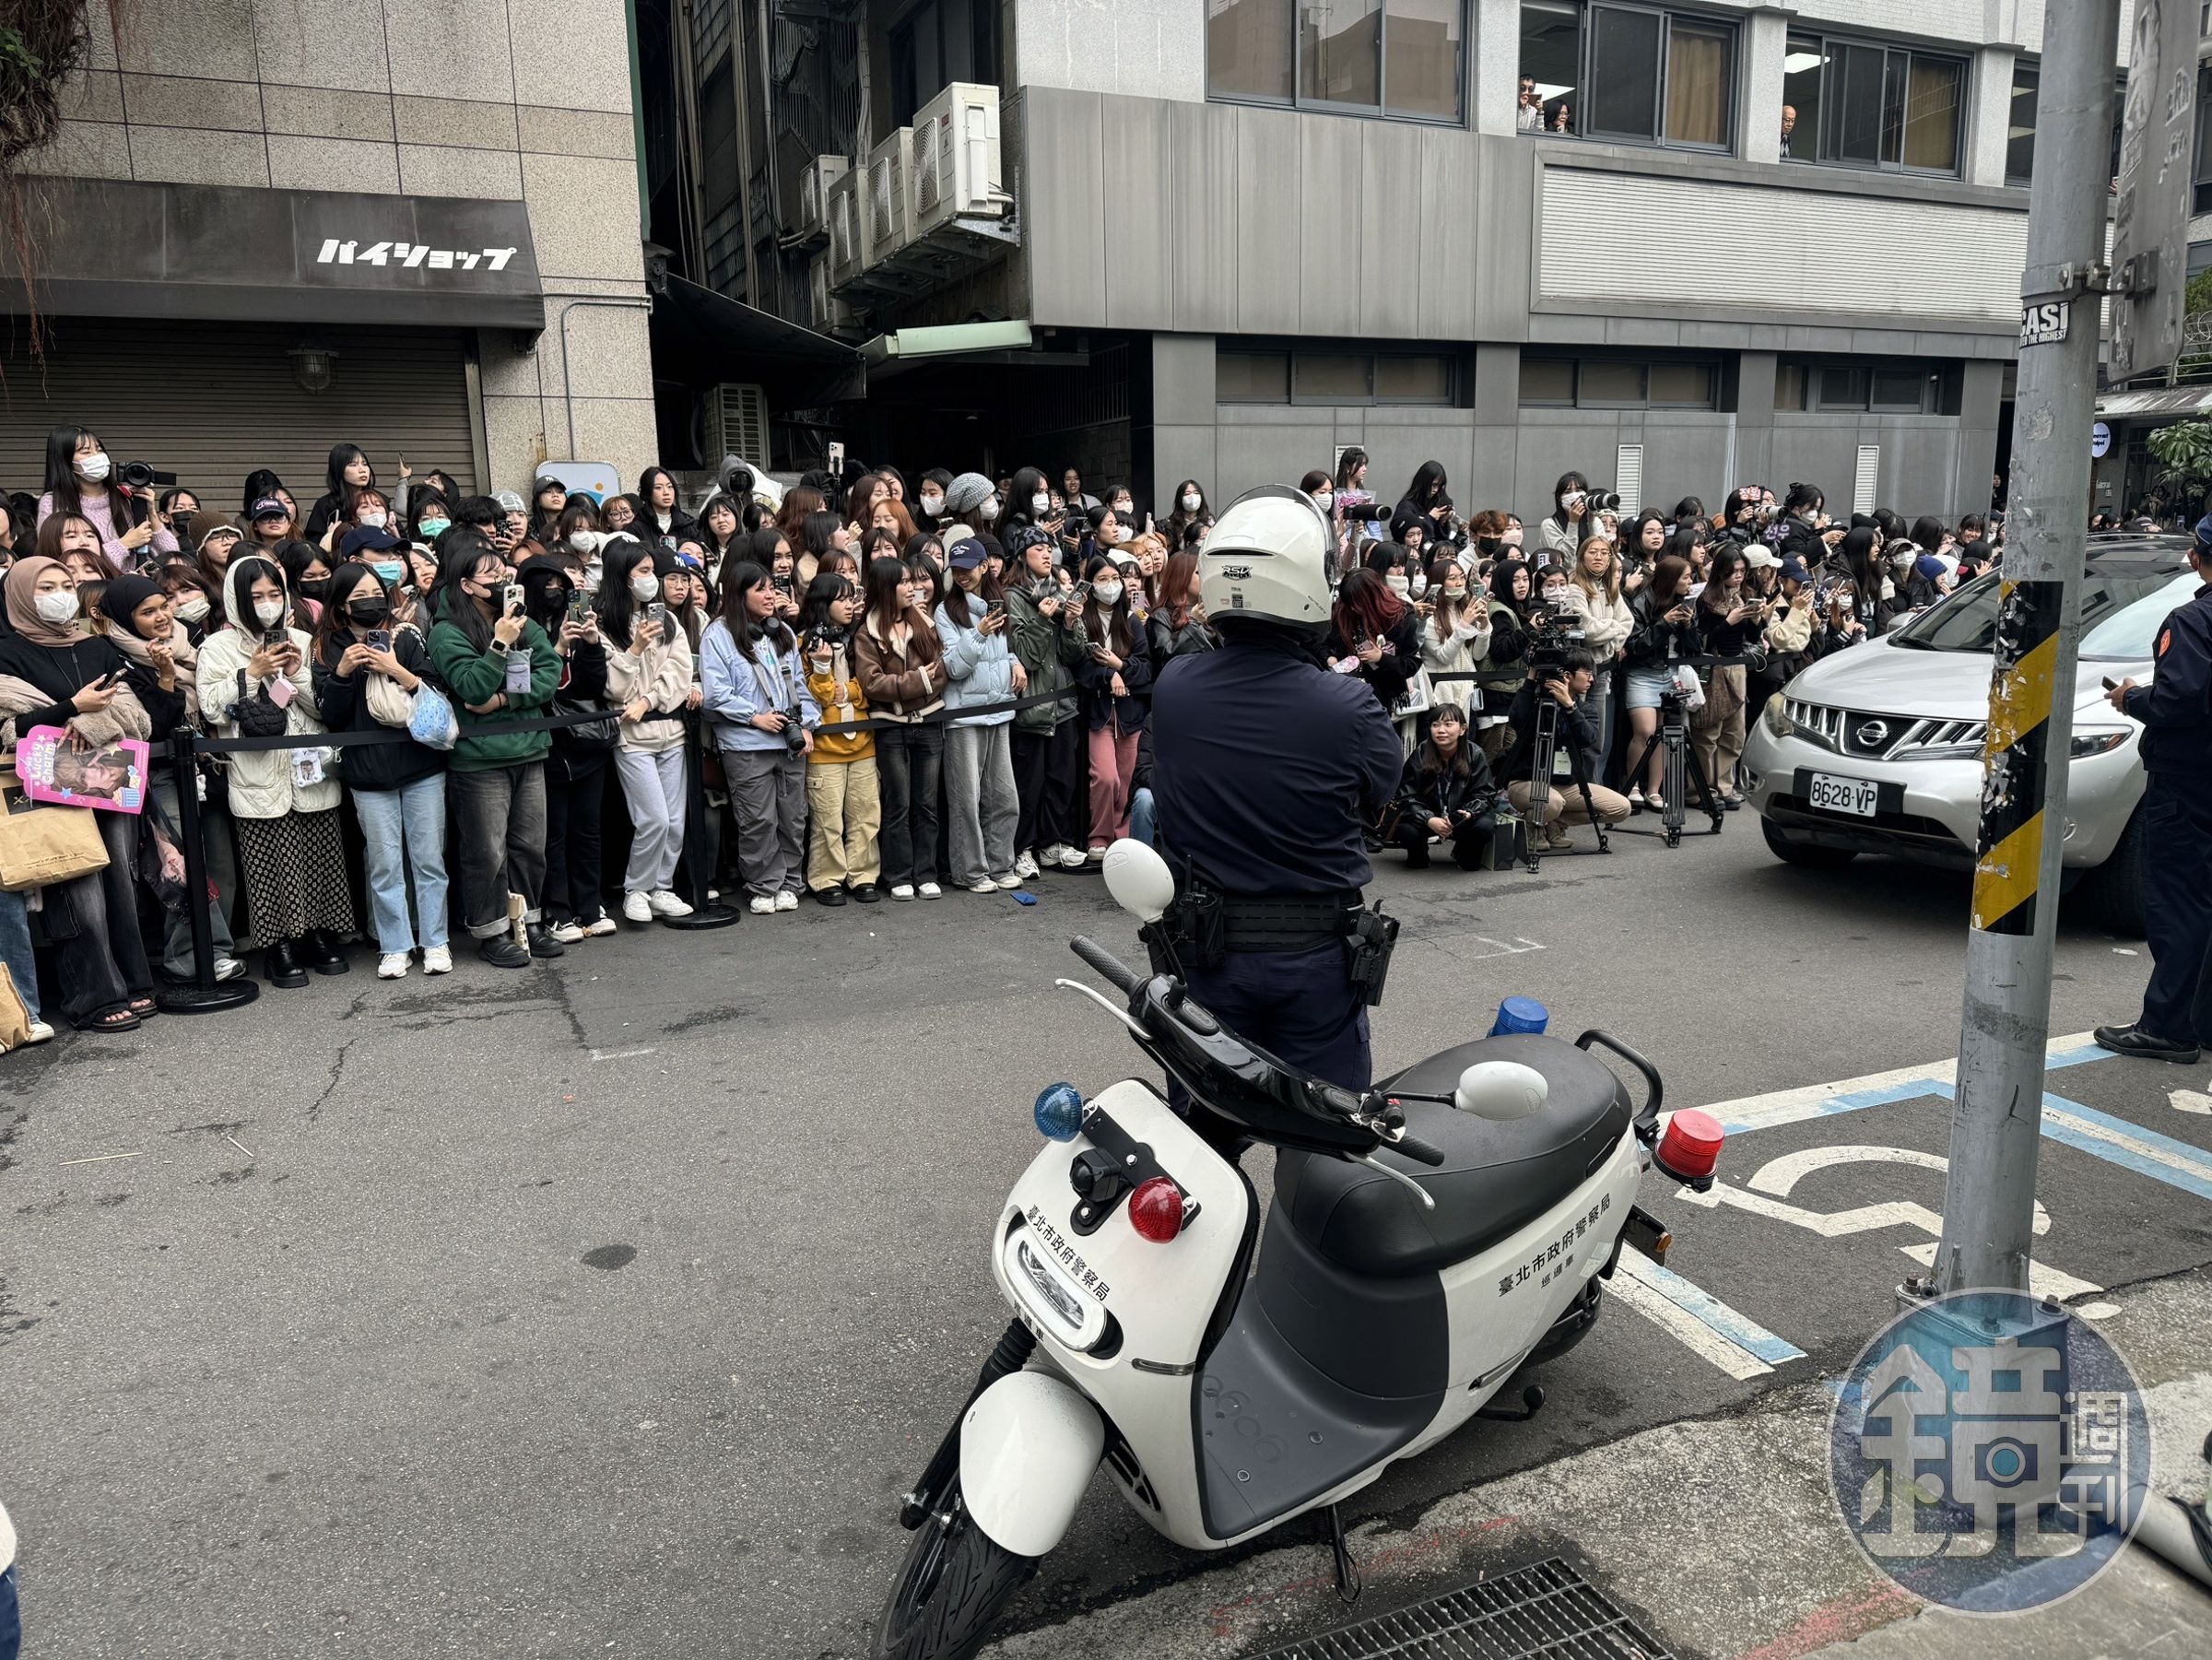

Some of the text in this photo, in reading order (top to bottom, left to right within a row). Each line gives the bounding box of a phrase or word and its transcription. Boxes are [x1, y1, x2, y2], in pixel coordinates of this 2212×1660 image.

[317, 239, 518, 271] パイショップ
[2028, 333, 2039, 346] THE
[2039, 329, 2068, 343] HIGHEST
[1764, 524, 1790, 540] 선우
[30, 742, 45, 780] Lucky
[41, 742, 56, 784] Charm
[1026, 1204, 1111, 1301] 臺北市政府警察局
[1499, 1193, 1611, 1298] 臺北市政府警察局
